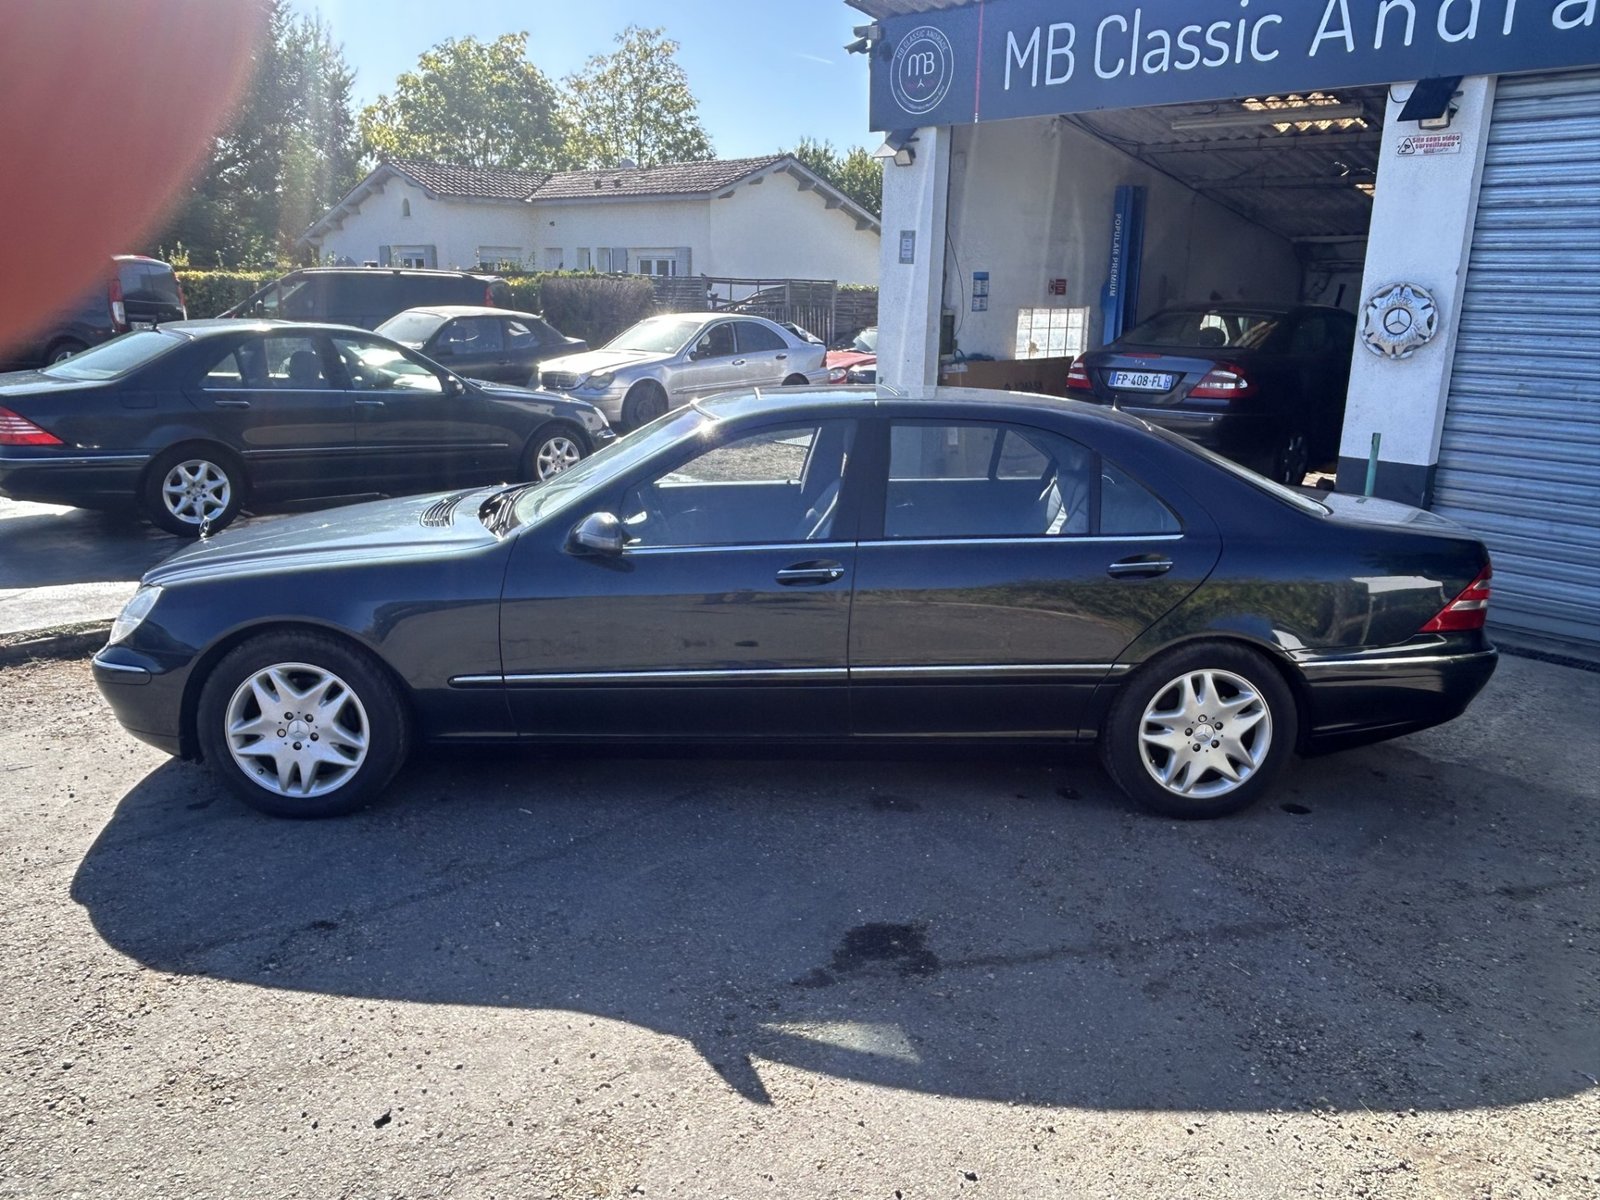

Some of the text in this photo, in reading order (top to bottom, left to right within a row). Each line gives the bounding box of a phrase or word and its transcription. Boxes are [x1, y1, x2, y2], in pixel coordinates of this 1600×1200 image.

[1004, 22, 1076, 91] MB
[1094, 0, 1283, 79] Classic
[1109, 213, 1122, 297] POPULAR PREMIUM
